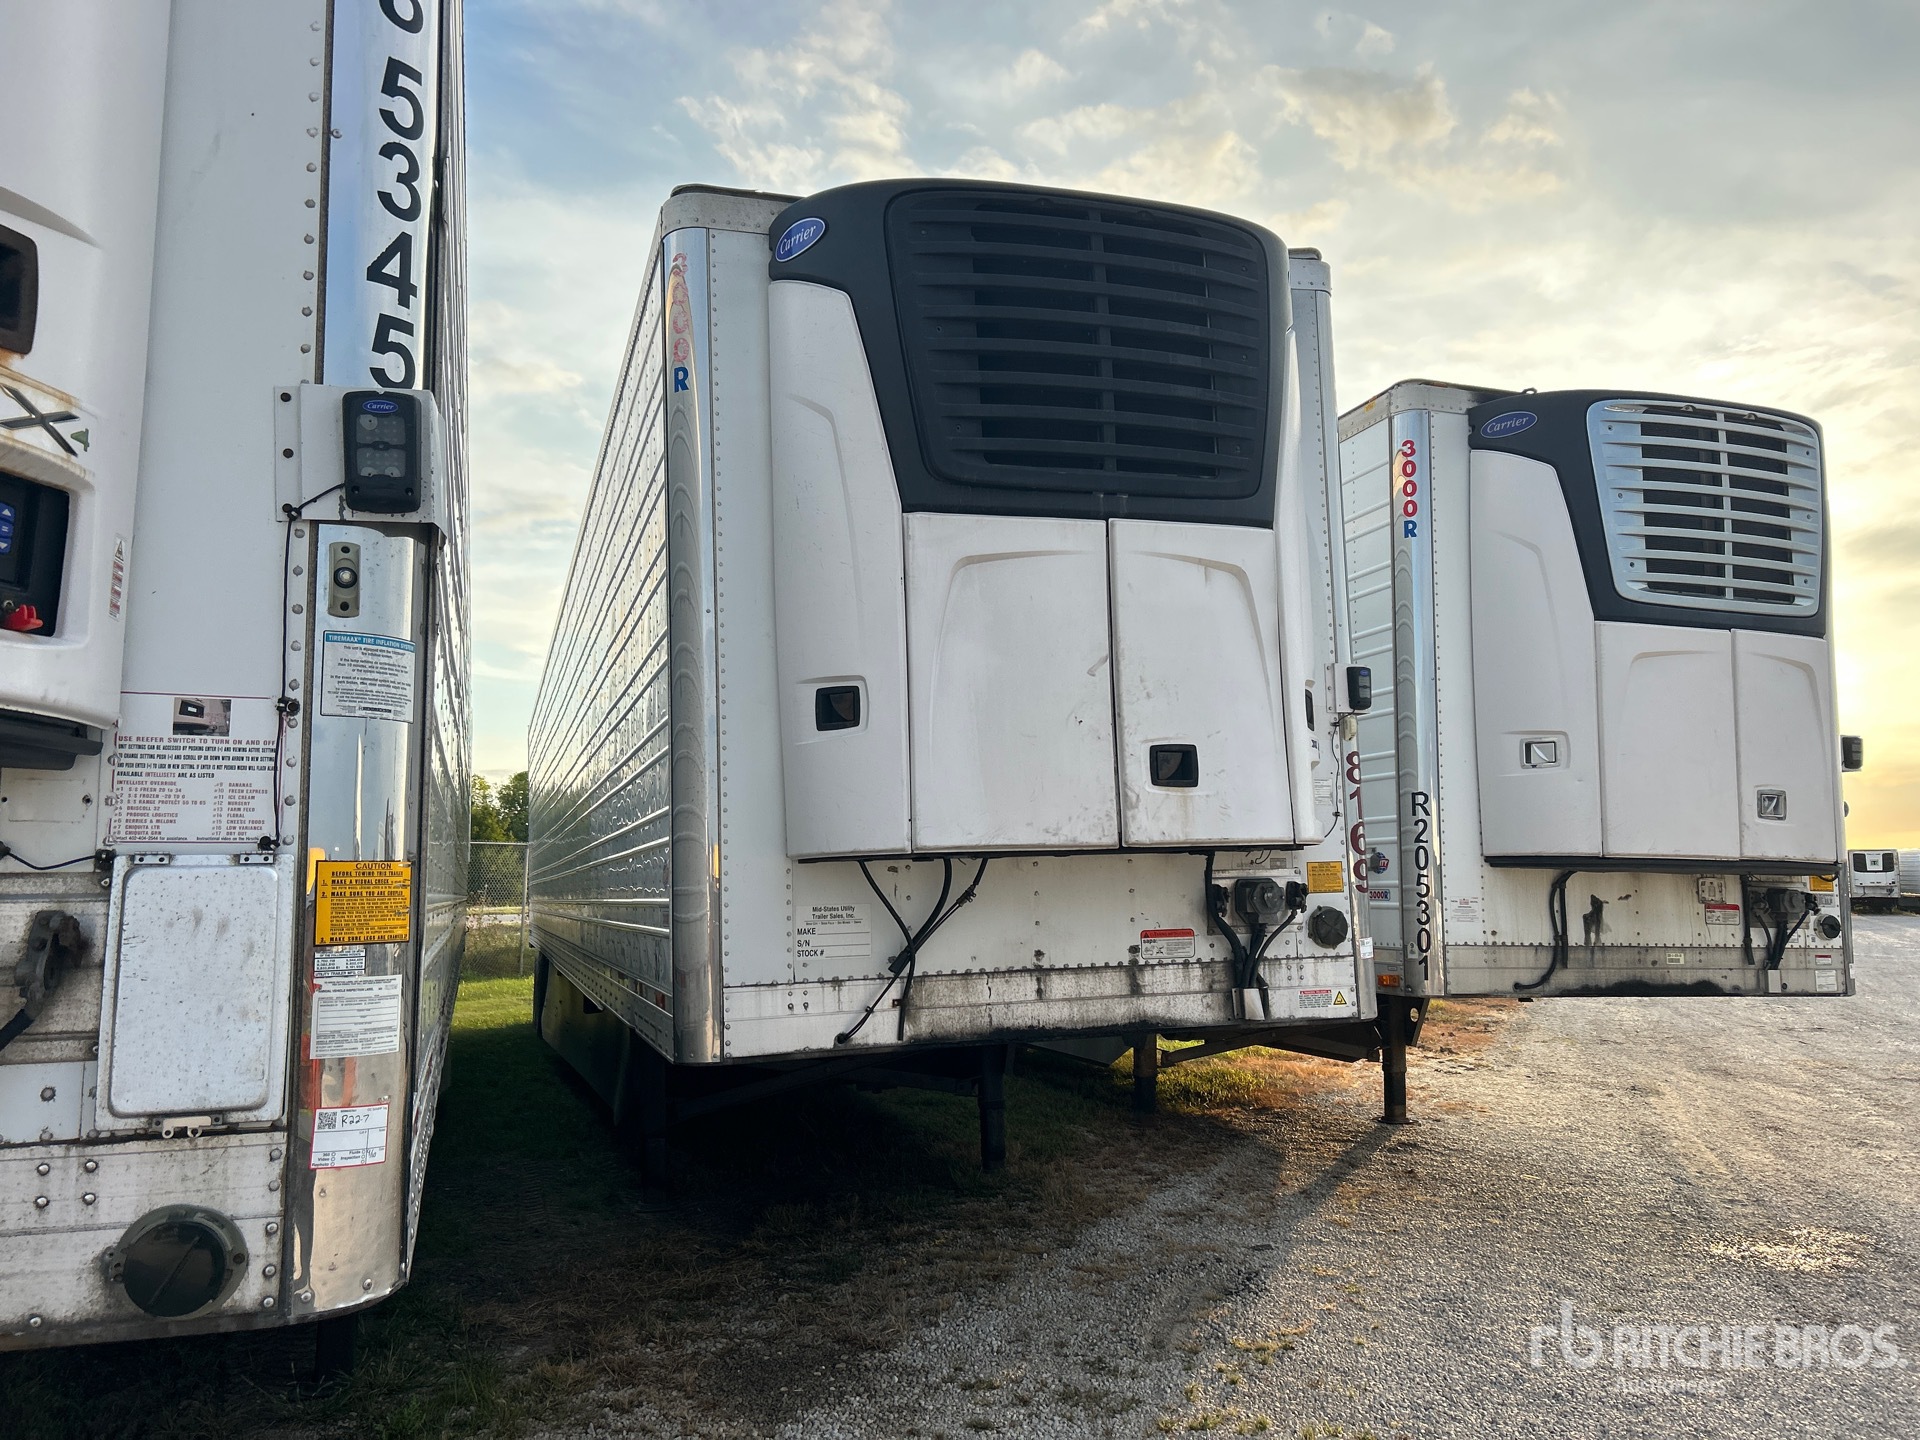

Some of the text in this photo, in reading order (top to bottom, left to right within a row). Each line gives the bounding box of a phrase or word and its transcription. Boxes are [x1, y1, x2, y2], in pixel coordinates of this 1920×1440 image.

[780, 225, 816, 254] Carrier
[1487, 416, 1529, 433] Carrier
[1402, 440, 1418, 539] 3000R
[376, 639, 399, 648] INFLATION
[1411, 792, 1431, 980] R205301
[1369, 891, 1388, 899] 3000R
[797, 940, 810, 948] S/N
